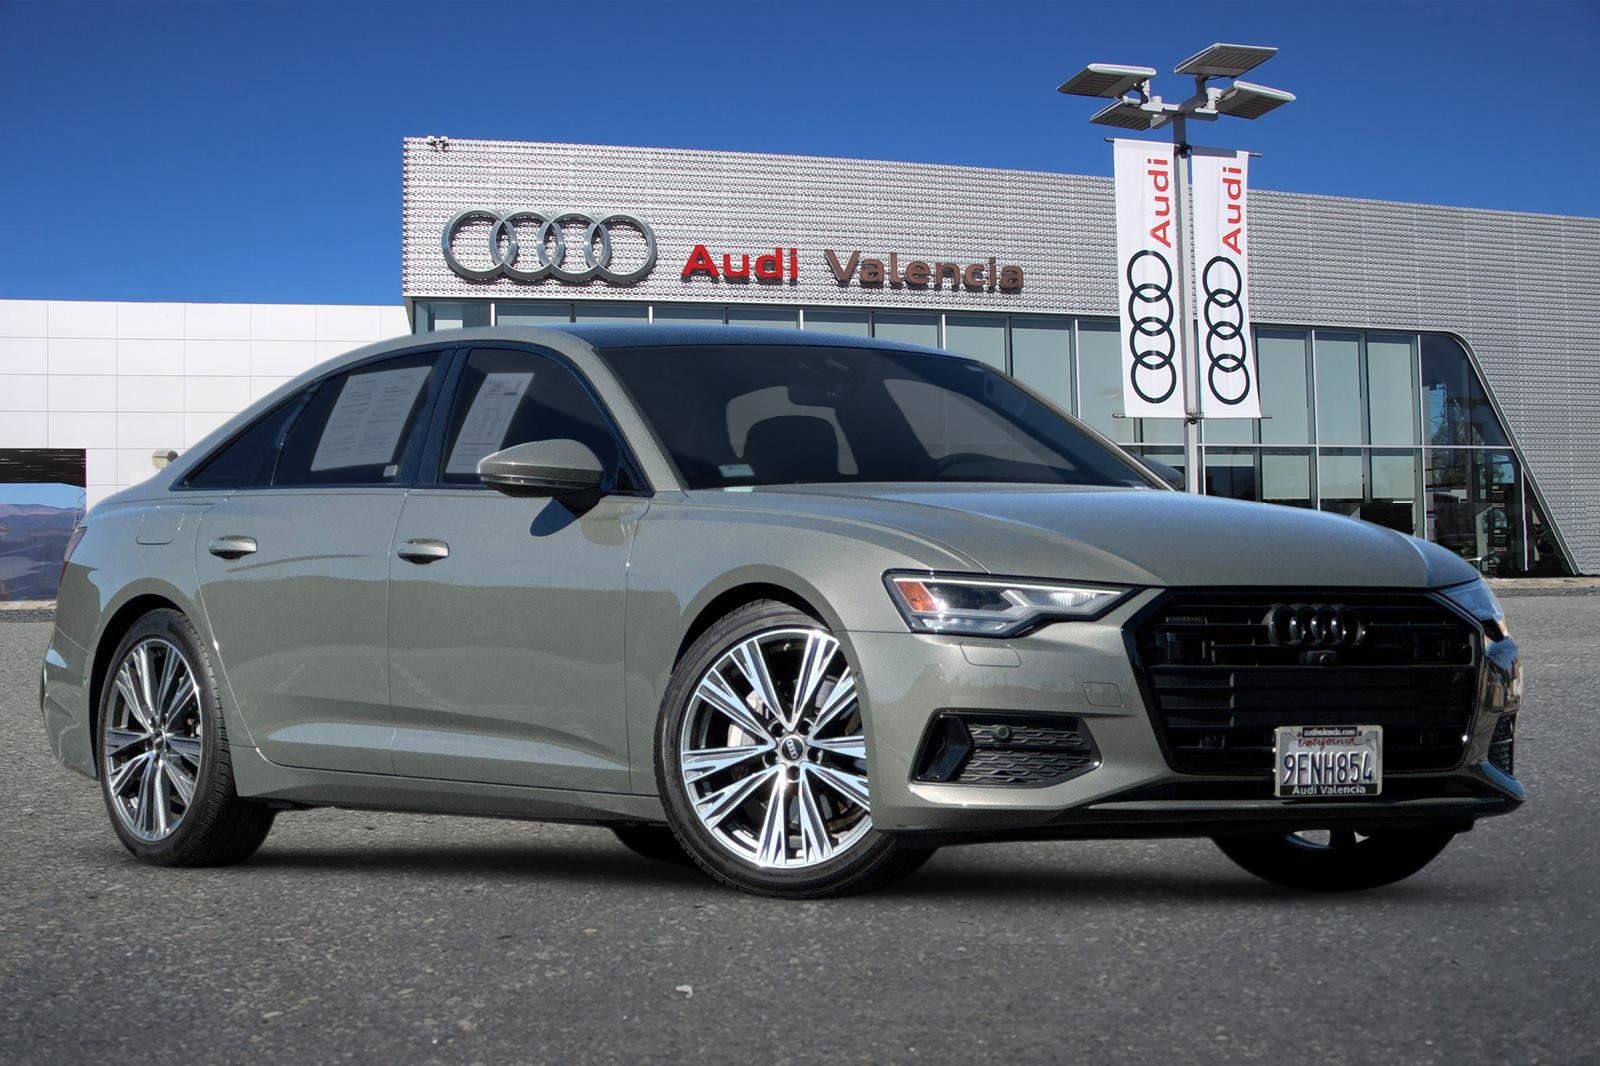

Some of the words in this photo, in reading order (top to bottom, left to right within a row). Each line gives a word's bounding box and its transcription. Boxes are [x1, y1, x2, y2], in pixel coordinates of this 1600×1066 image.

[1147, 158, 1172, 249] Audi
[1222, 166, 1242, 255] Audi
[681, 244, 798, 281] Audi
[824, 249, 1024, 291] Valencia
[1291, 785, 1317, 795] Audi
[1320, 785, 1366, 794] Valencia
